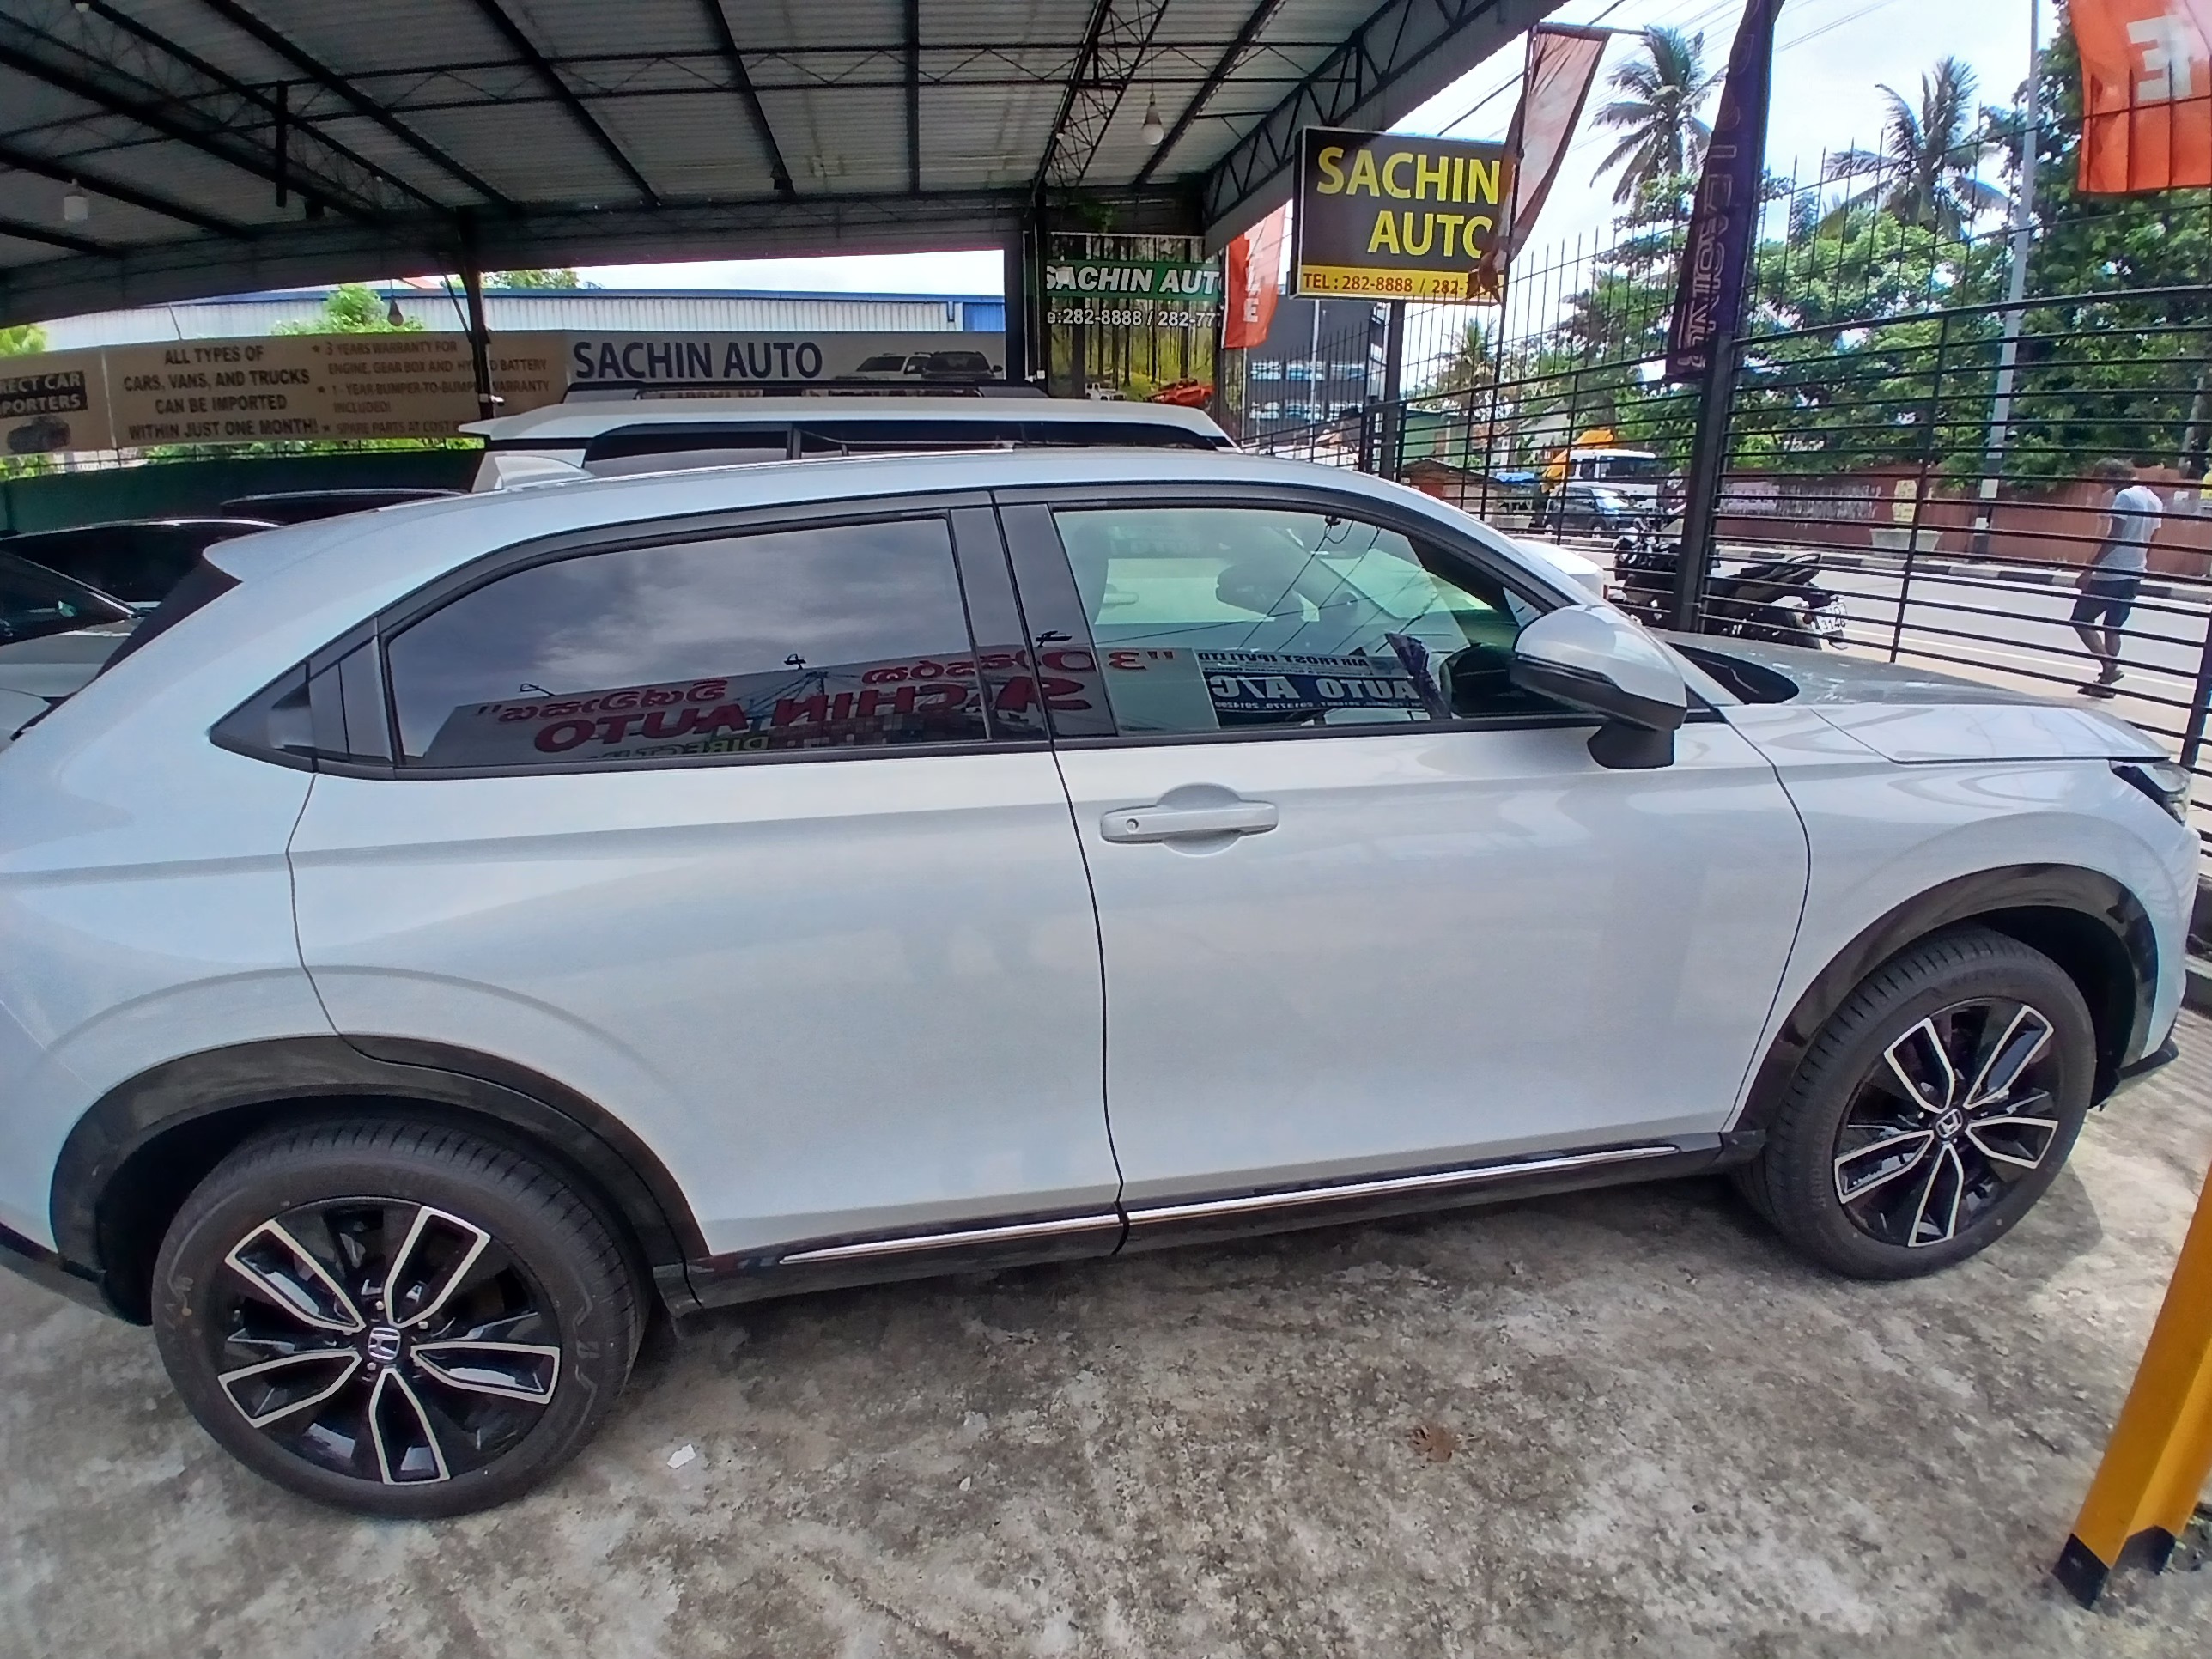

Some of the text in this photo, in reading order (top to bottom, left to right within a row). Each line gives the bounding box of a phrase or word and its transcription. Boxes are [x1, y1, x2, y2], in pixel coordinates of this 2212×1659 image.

[1316, 146, 1500, 205] SACHIN
[1046, 265, 1153, 293] SACHIN
[1159, 269, 1223, 295] AUT
[1342, 275, 1413, 293] 282-8888
[1419, 278, 1425, 294] /
[1146, 310, 1154, 326] /
[165, 345, 264, 365] ALL TYPES OF
[325, 340, 458, 356] 3 YEARS WARRANTY FOR
[373, 361, 402, 374] GEAR
[404, 360, 426, 373] BOX
[428, 360, 454, 373] AND
[457, 359, 498, 372] HYD
[500, 357, 548, 372] BATTERY
[574, 341, 823, 380] SACHIN AUTO
[45, 372, 81, 390] CAR
[123, 368, 311, 392] CARS, VANS, AND TRUCKS
[0, 393, 81, 415] PORTERS
[155, 394, 289, 415] CAN BE IMPORTED
[128, 417, 319, 441] WITHIN JUST ONE MONTH!
[337, 423, 369, 434] SPARE
[372, 422, 405, 434] PARTS
[408, 422, 420, 432] AT
[422, 420, 451, 433] COST
